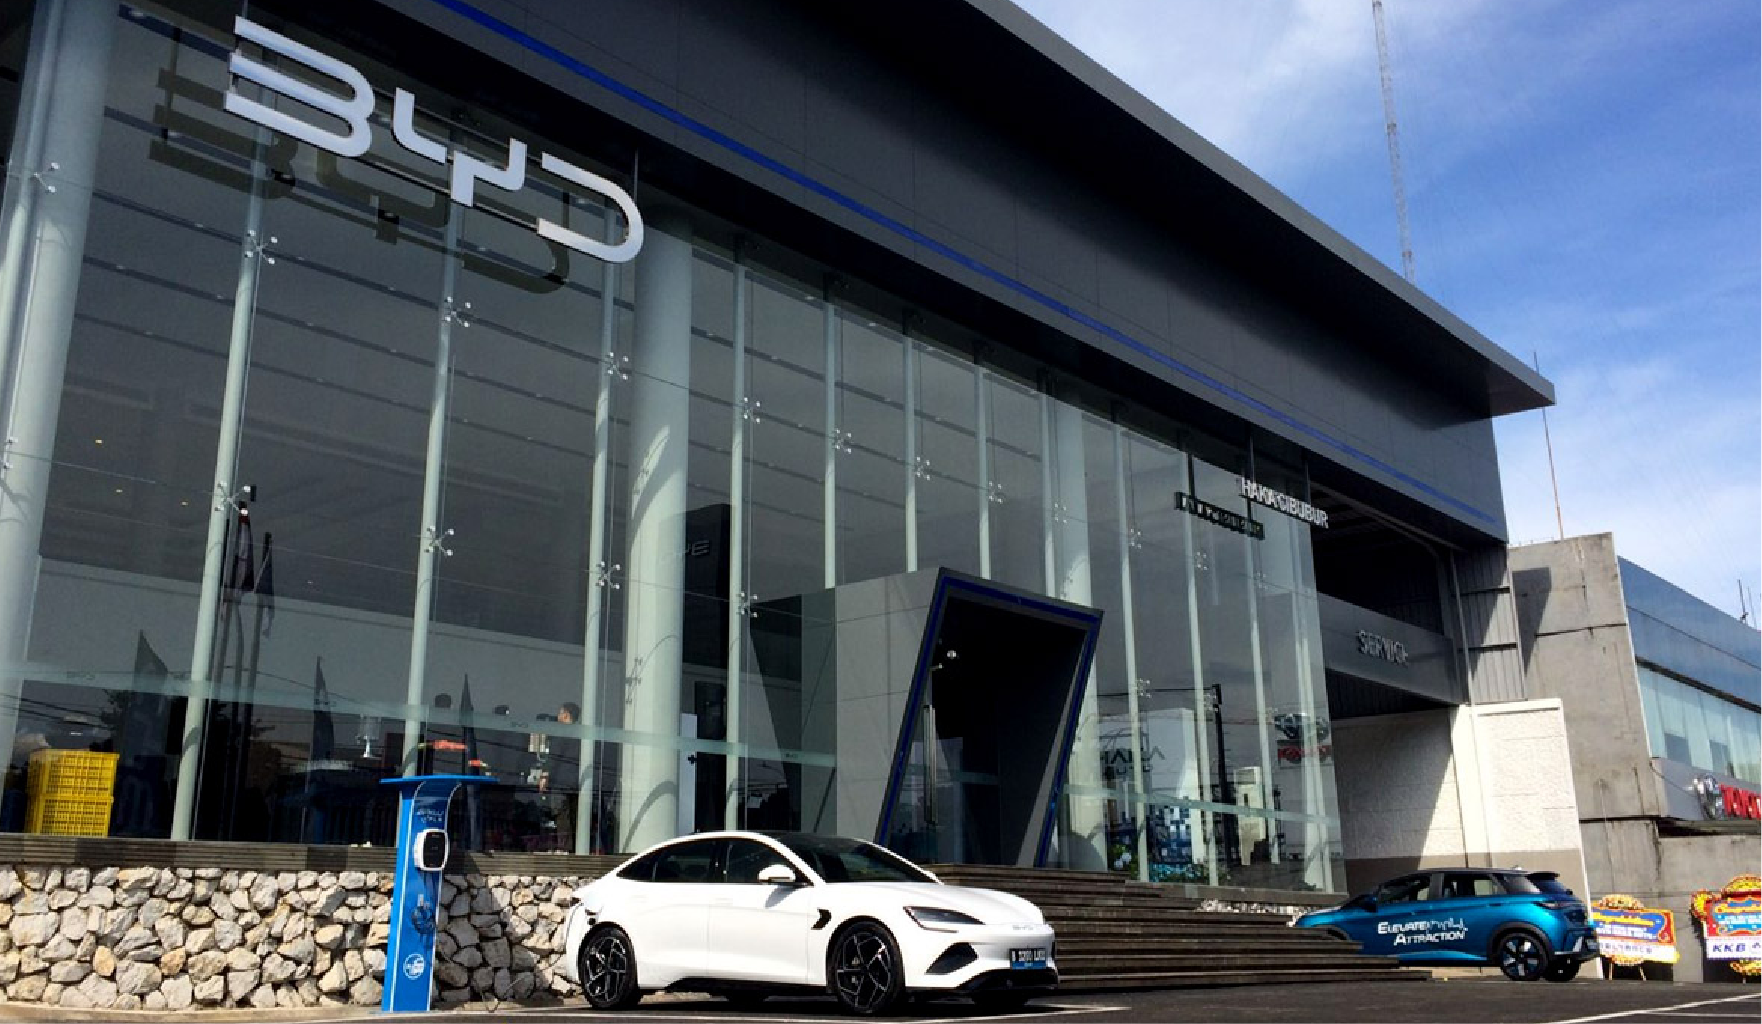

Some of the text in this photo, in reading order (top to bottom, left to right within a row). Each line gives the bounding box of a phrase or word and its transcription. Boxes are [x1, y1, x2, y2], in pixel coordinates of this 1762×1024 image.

[223, 16, 645, 263] BYD
[1241, 476, 1279, 508] HAKA
[1278, 492, 1330, 529] CIBUBUR
[1377, 920, 1428, 935] ELEVATE
[1393, 930, 1466, 946] ATTRACTION
